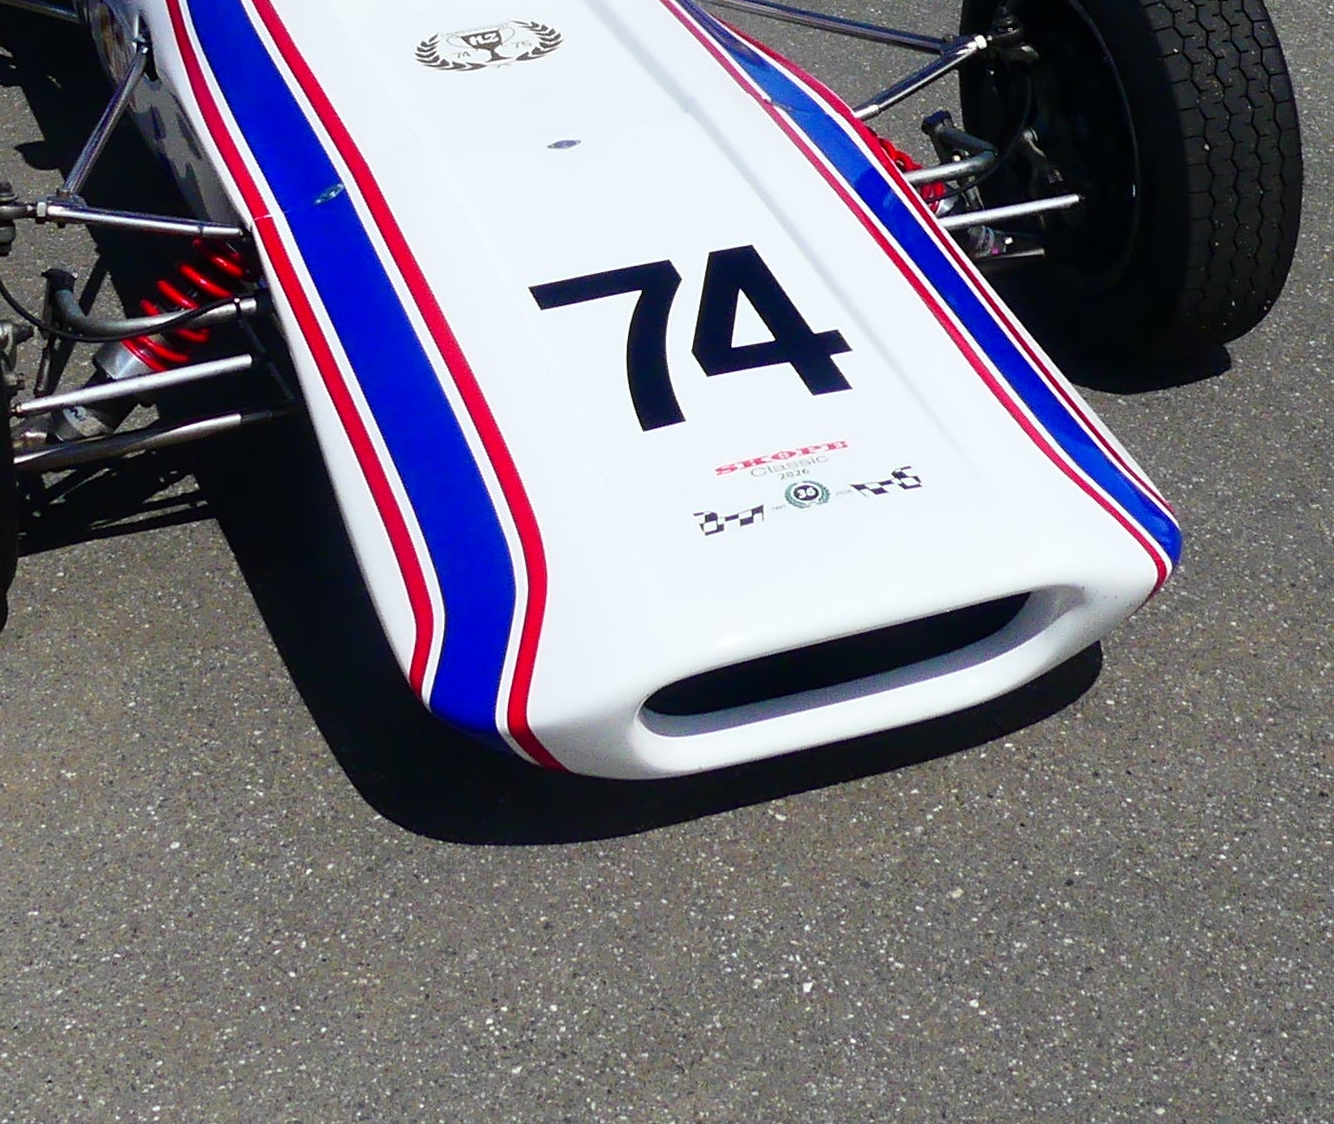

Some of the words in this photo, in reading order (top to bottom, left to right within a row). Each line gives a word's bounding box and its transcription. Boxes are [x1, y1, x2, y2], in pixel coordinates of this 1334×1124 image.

[528, 244, 854, 432] 74
[714, 440, 849, 476] SKOPE
[750, 455, 829, 478] Classic
